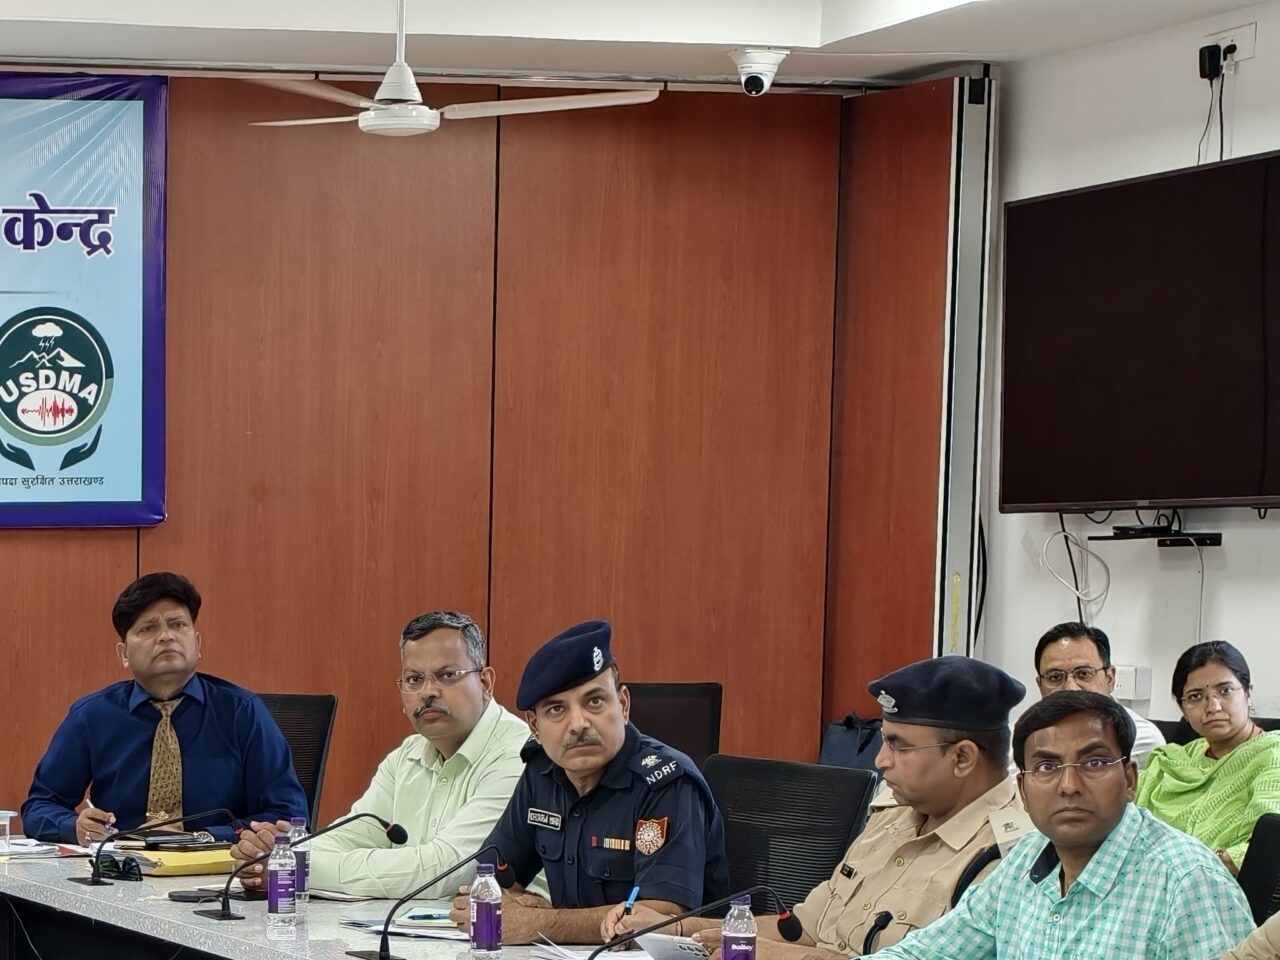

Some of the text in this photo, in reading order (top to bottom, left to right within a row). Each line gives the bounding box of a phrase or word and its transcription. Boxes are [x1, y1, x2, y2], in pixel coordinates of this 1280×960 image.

[1, 192, 116, 257] केन्द्र
[21, 475, 56, 489] सुरक्षित
[58, 476, 105, 487] उत्तराखण्ड
[645, 760, 677, 785] NDRF
